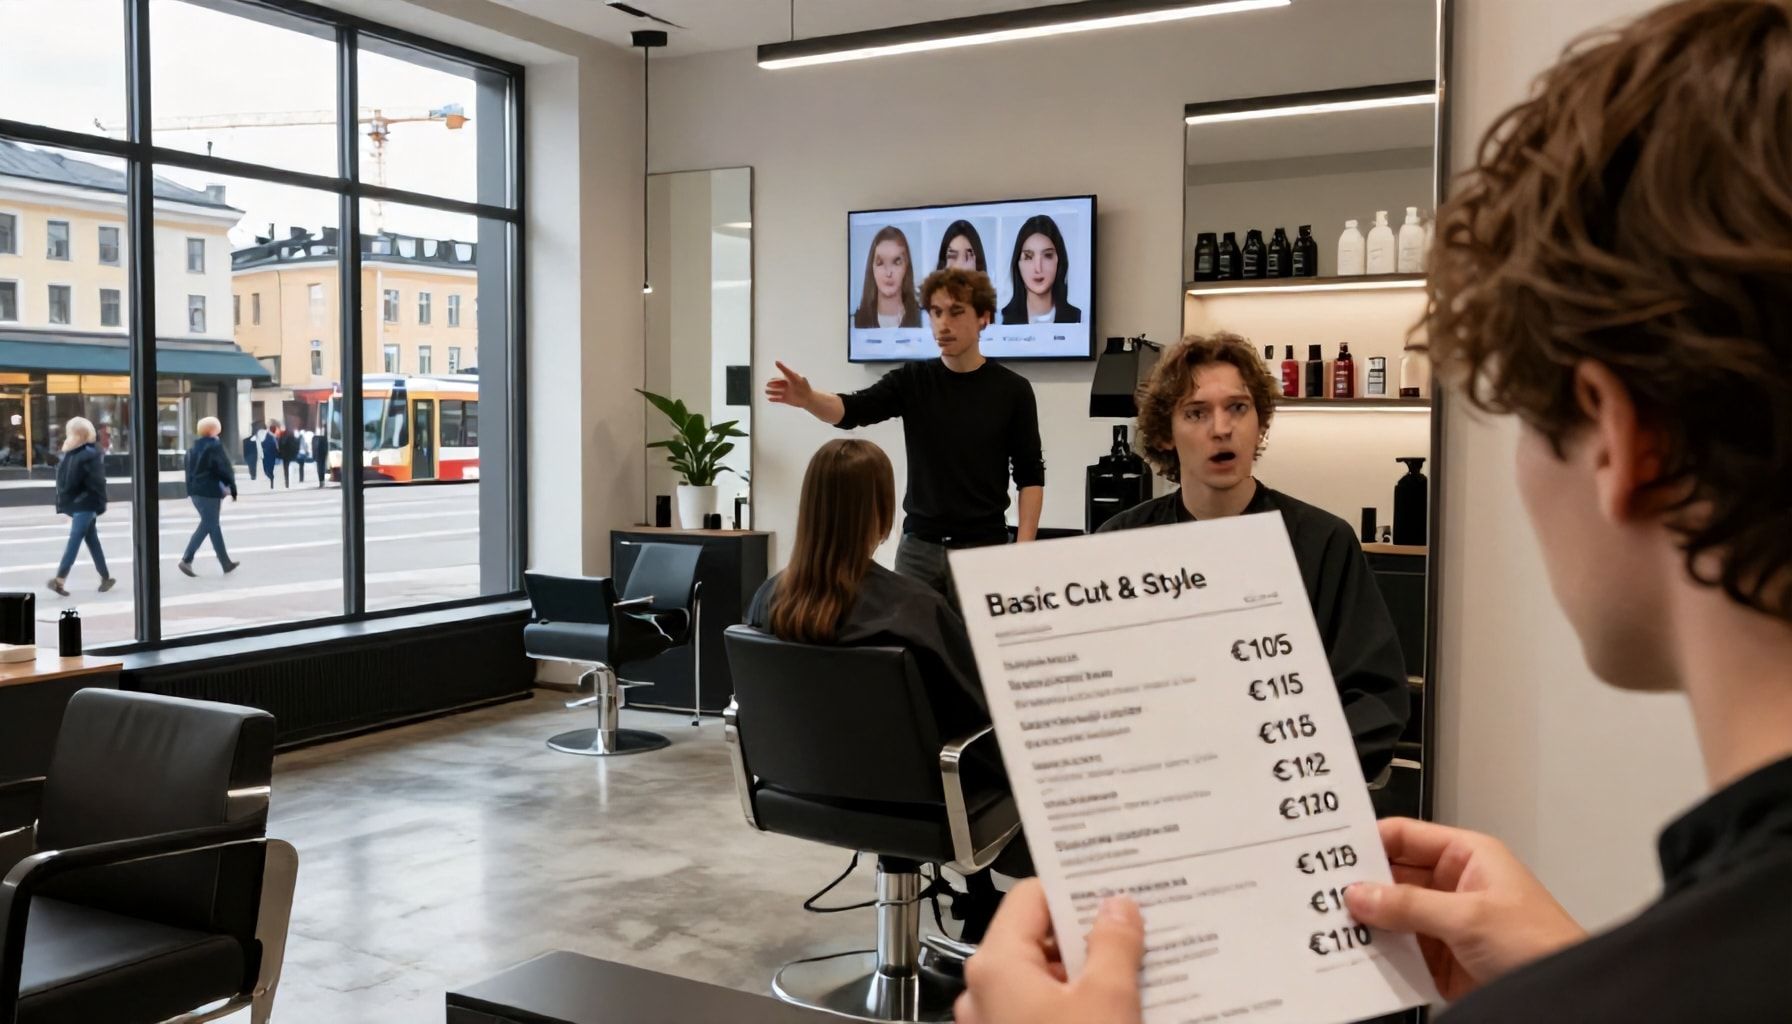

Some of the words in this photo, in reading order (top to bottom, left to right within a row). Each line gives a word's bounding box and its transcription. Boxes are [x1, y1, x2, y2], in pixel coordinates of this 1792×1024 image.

[985, 586, 1060, 617] Basic
[1065, 580, 1113, 606] Cut
[1118, 576, 1138, 600] &
[1142, 567, 1208, 599] Style
[1231, 633, 1293, 661] €105
[1248, 672, 1304, 701] €115
